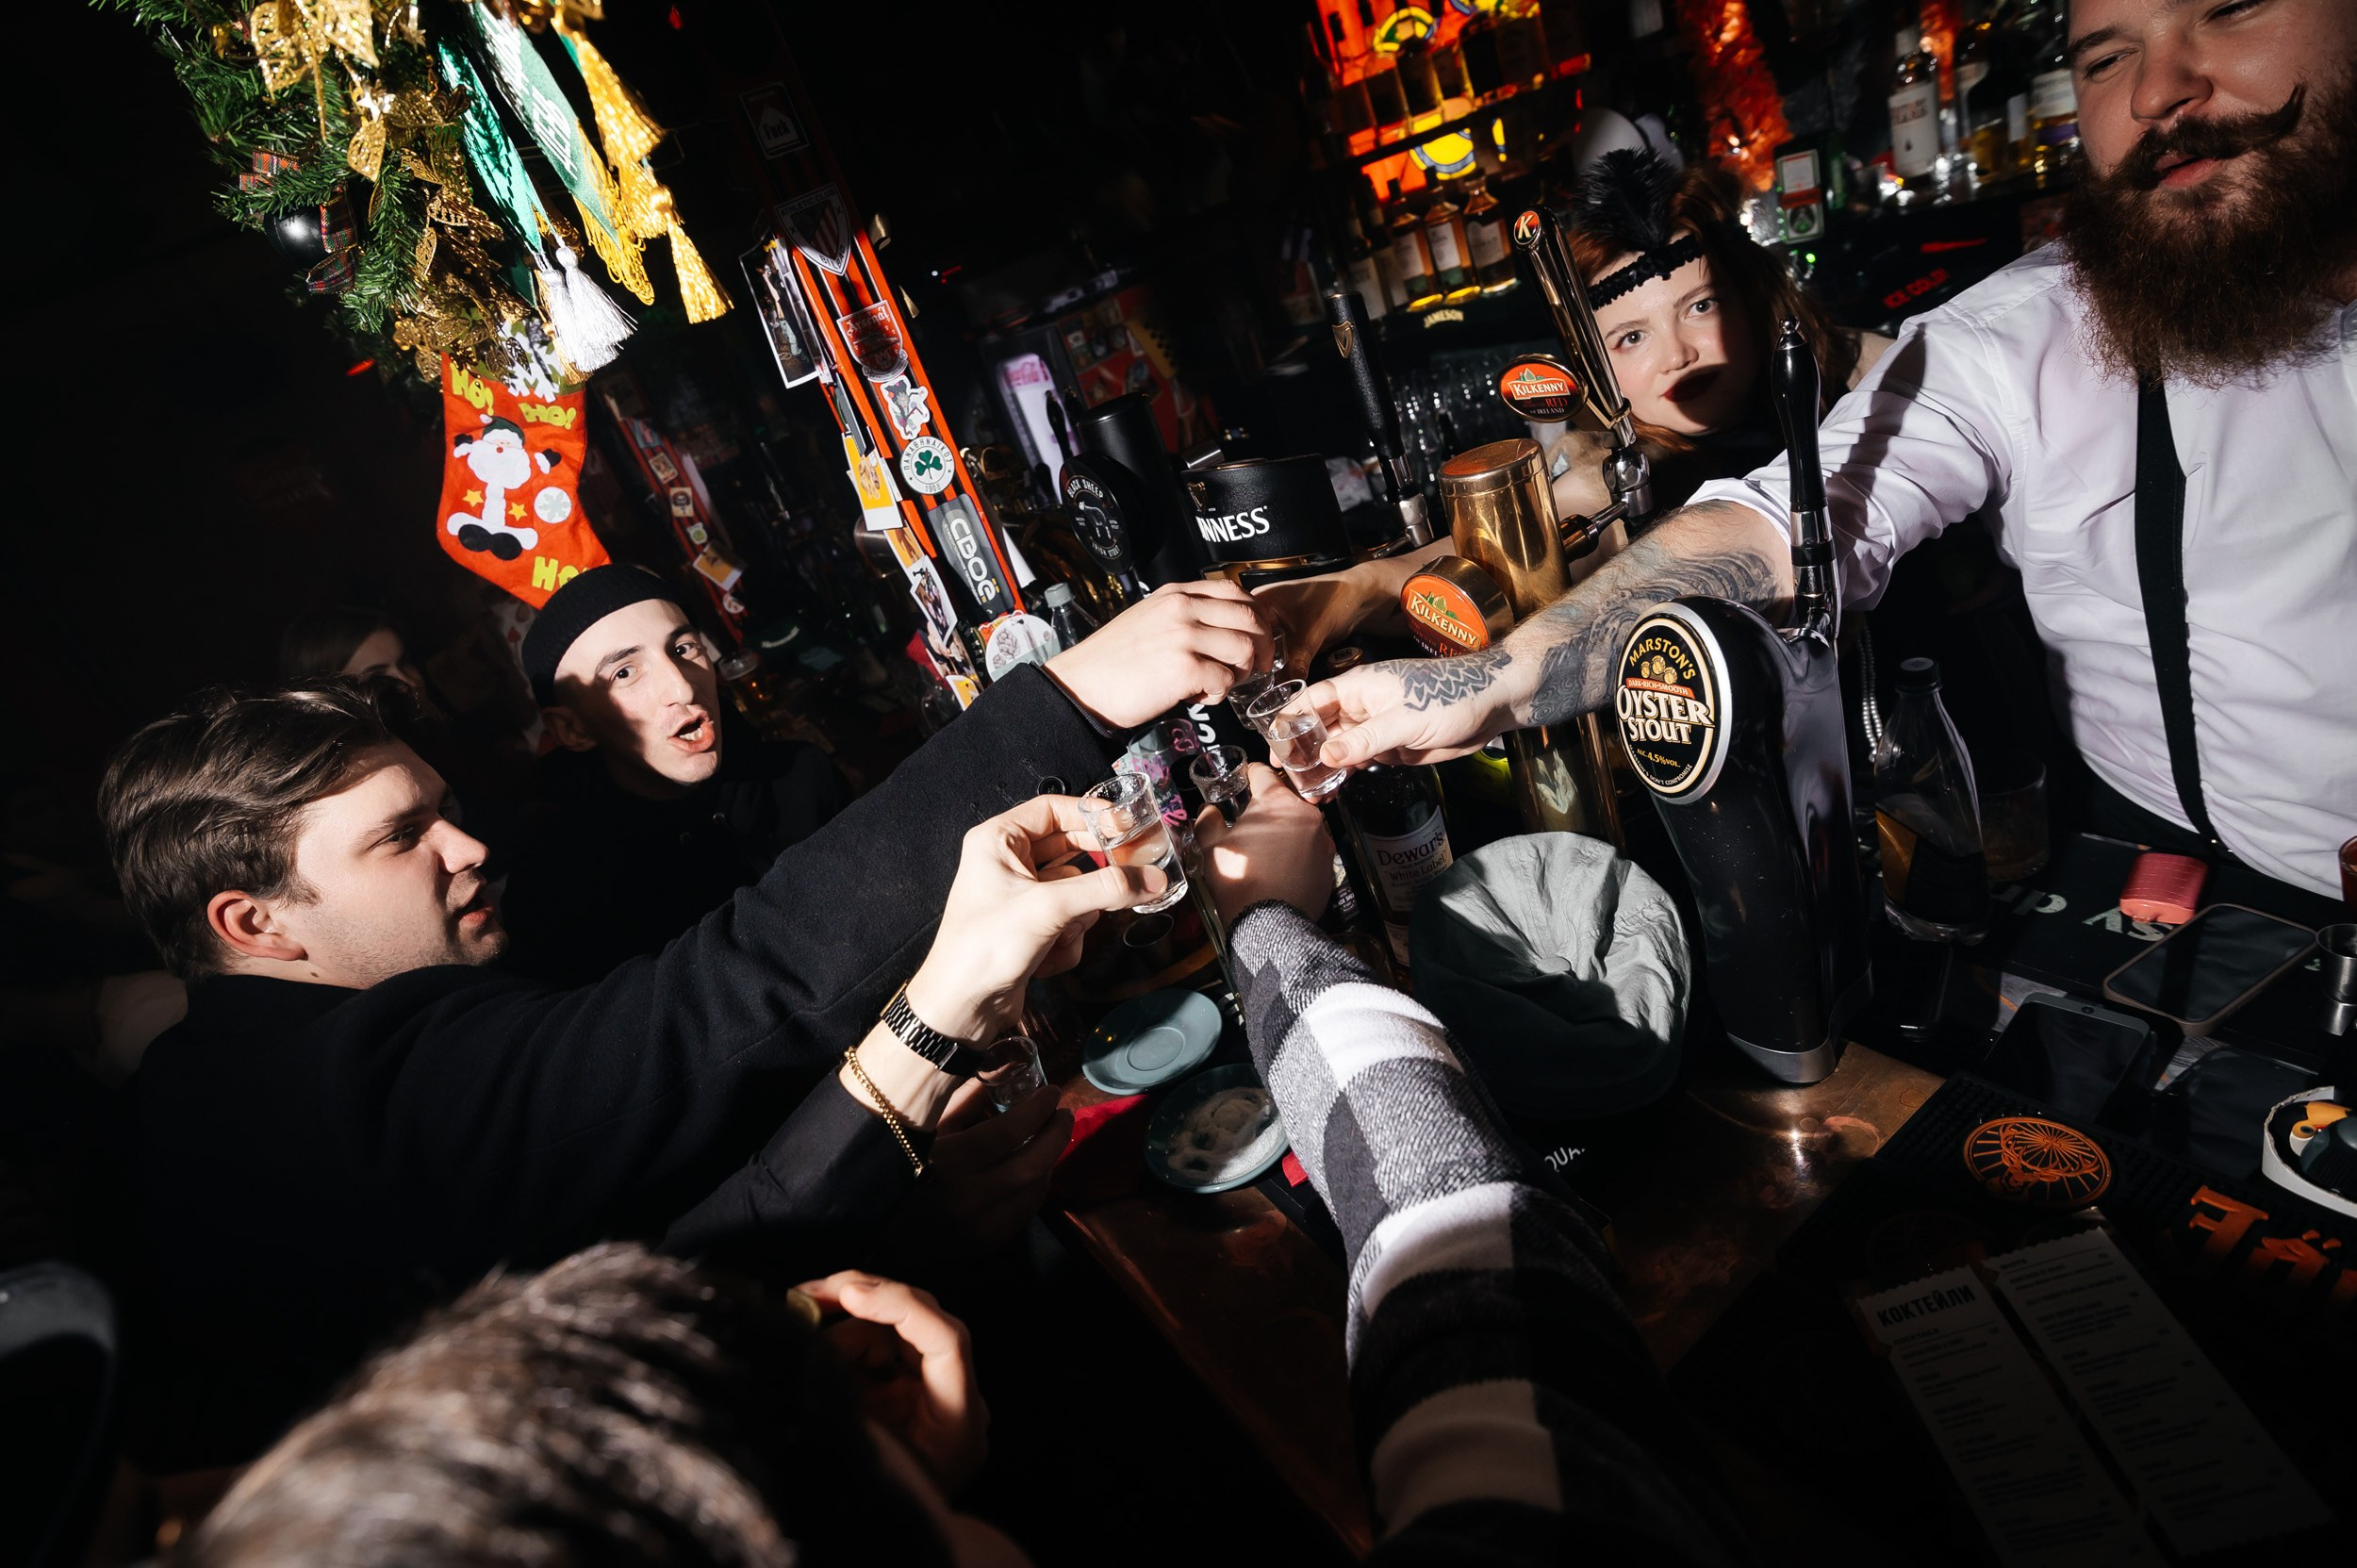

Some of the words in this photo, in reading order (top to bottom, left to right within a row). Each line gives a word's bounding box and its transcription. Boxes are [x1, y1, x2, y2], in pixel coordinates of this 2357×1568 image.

[761, 119, 791, 140] Fuck
[781, 196, 814, 216] ATHLETIC
[815, 189, 837, 203] CLUB
[1518, 215, 1534, 240] K
[820, 245, 847, 271] BILBAO
[846, 305, 890, 336] Arsenal
[1512, 382, 1565, 396] KILKENNY
[519, 403, 578, 431] HO!
[925, 483, 942, 493] 1908
[1066, 478, 1081, 498] BLACK
[1081, 479, 1104, 499] SHEEP
[532, 555, 588, 592] HO
[1410, 595, 1477, 646] KILKENNY
[1629, 636, 1696, 681] MARSTON'S
[1617, 685, 1715, 728] OYSTER
[1627, 717, 1691, 744] STOUT
[1876, 1284, 1977, 1328] КОКТЕЙЛИ
[1893, 1328, 1940, 1346] COCKTAILS
